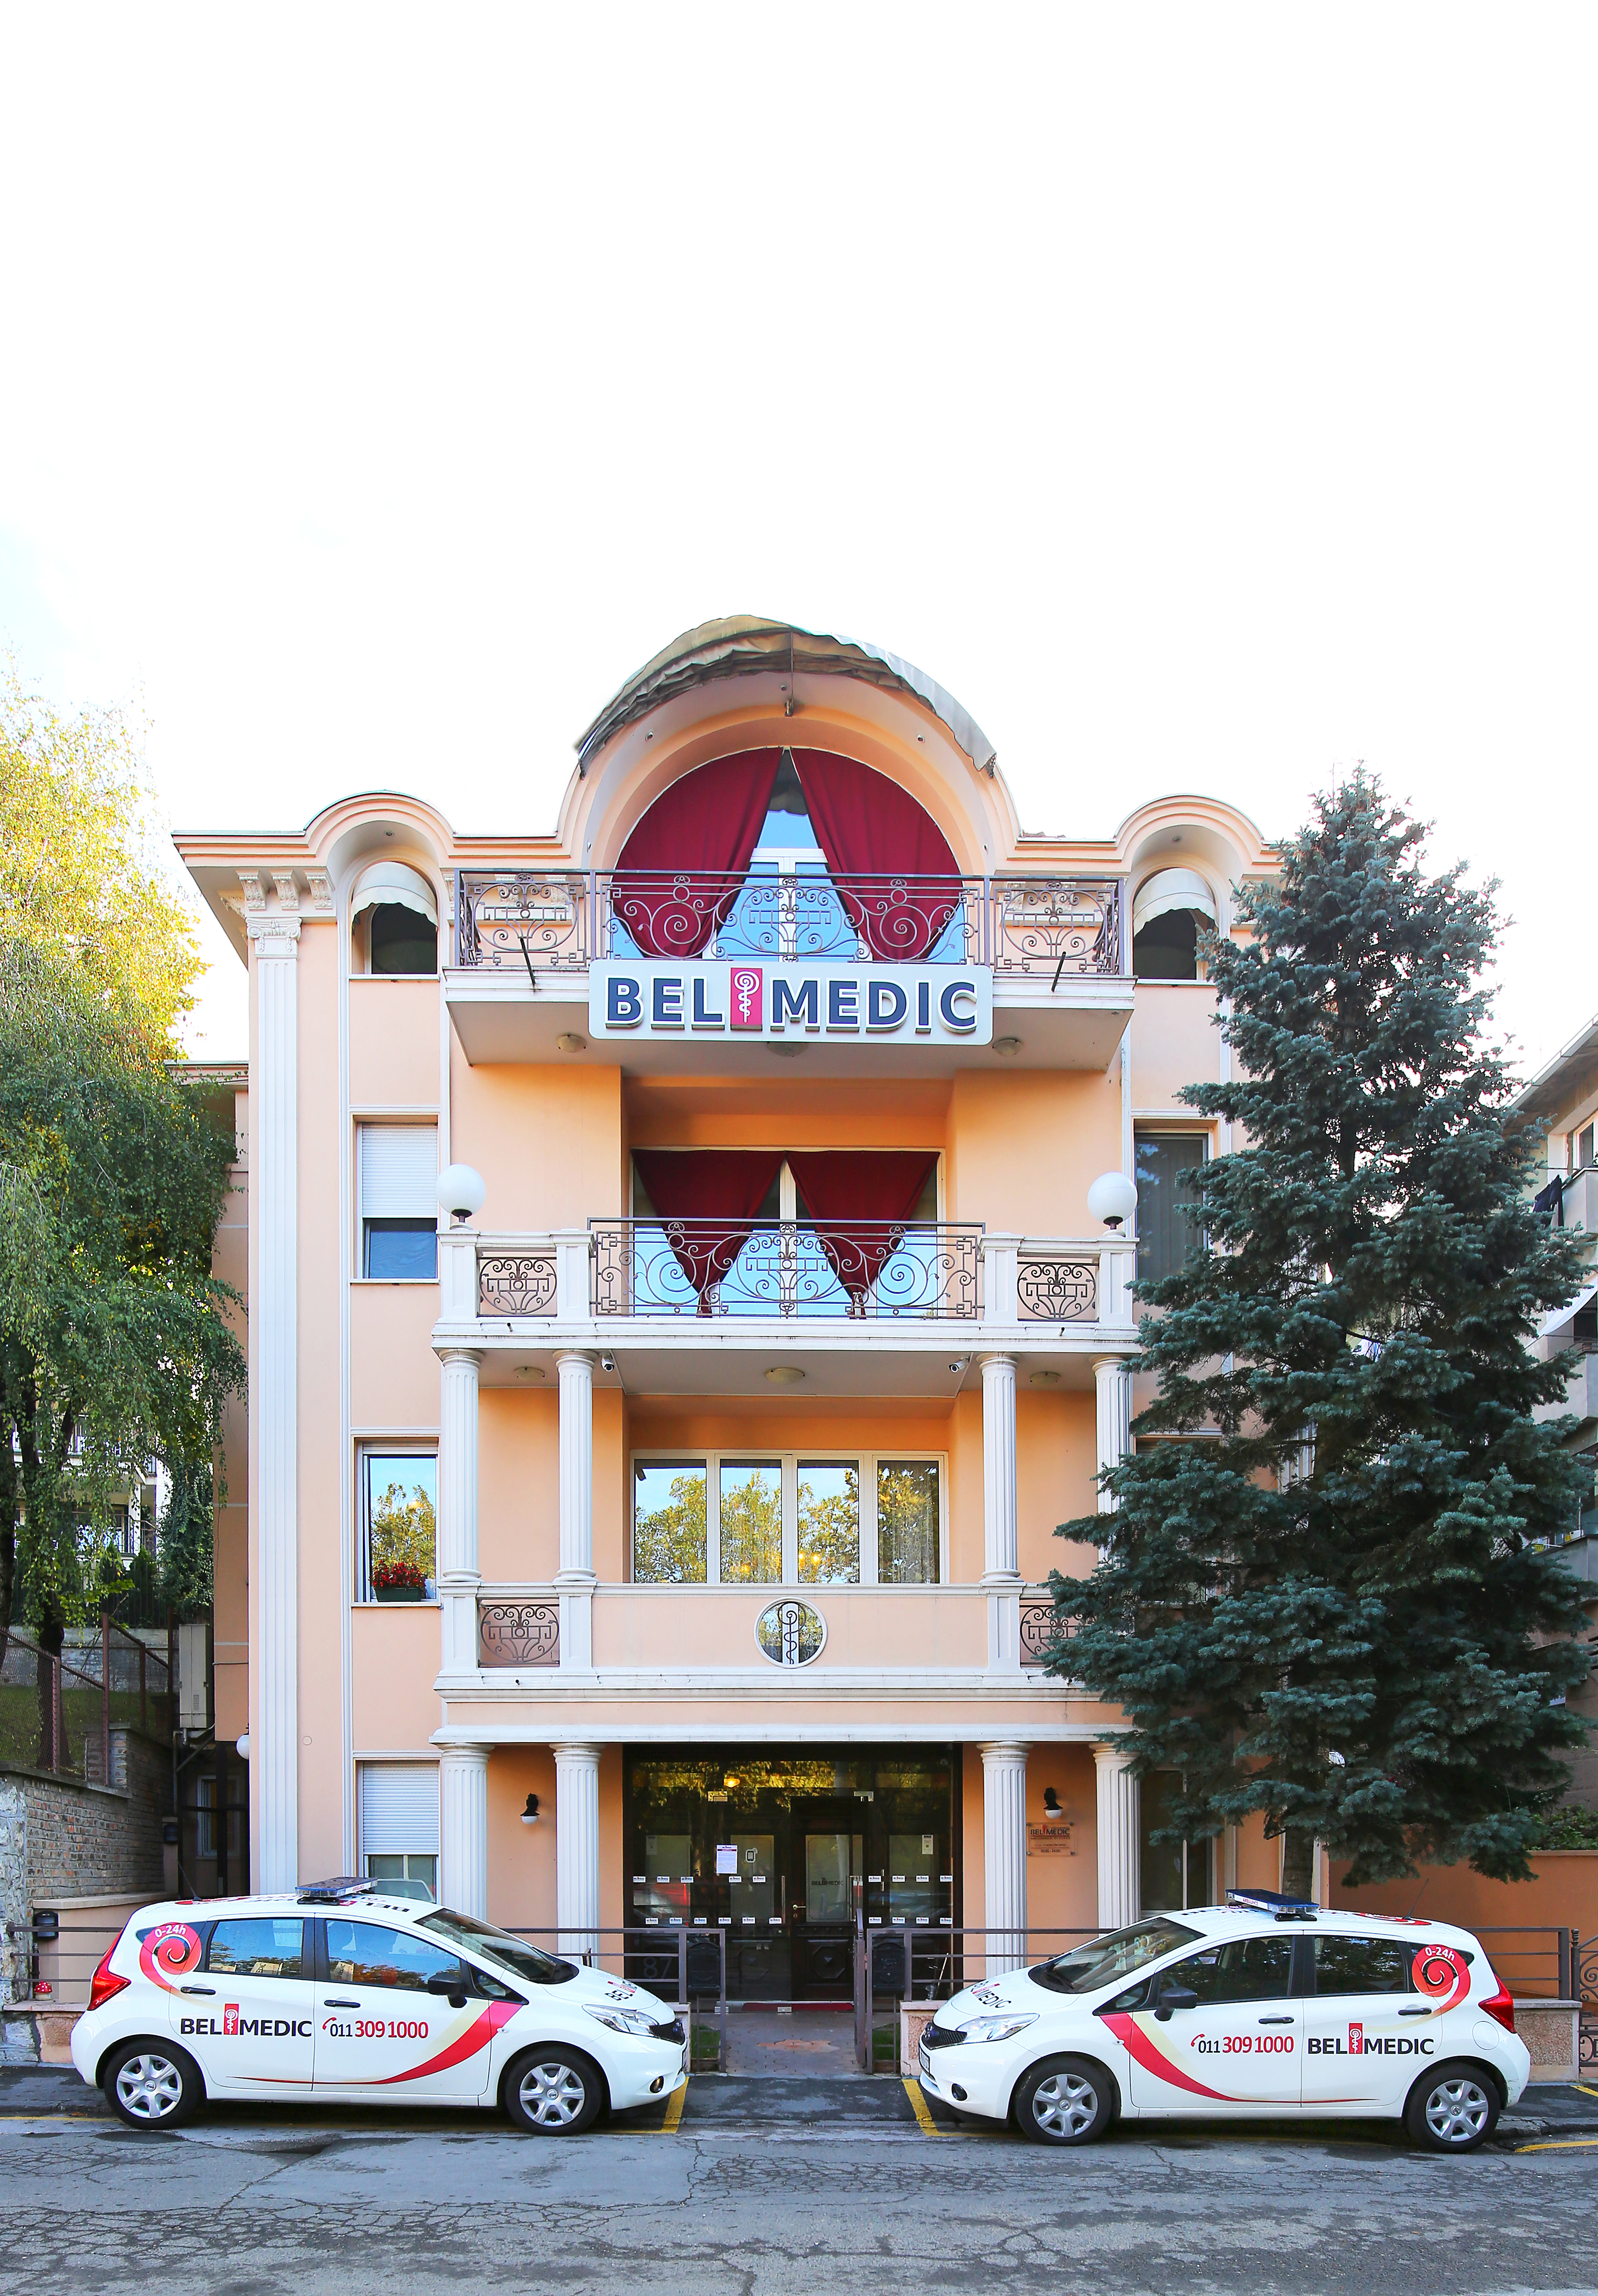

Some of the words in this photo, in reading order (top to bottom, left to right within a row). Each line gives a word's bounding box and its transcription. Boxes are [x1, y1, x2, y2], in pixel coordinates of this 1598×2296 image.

[155, 1924, 186, 1938] 0-24h
[1425, 1946, 1455, 1961] 0-24h
[643, 1957, 673, 1979] 87
[180, 2018, 222, 2035] BEL
[239, 2019, 312, 2037] MEDIC
[330, 2023, 353, 2037] 011
[355, 2020, 385, 2038] 309
[388, 2021, 429, 2038] 1000
[1198, 2040, 1220, 2054] 011
[1222, 2036, 1252, 2054] 309
[1255, 2036, 1294, 2054] 1000
[1308, 2038, 1347, 2054] BEL
[1364, 2038, 1434, 2055] MEDIC
